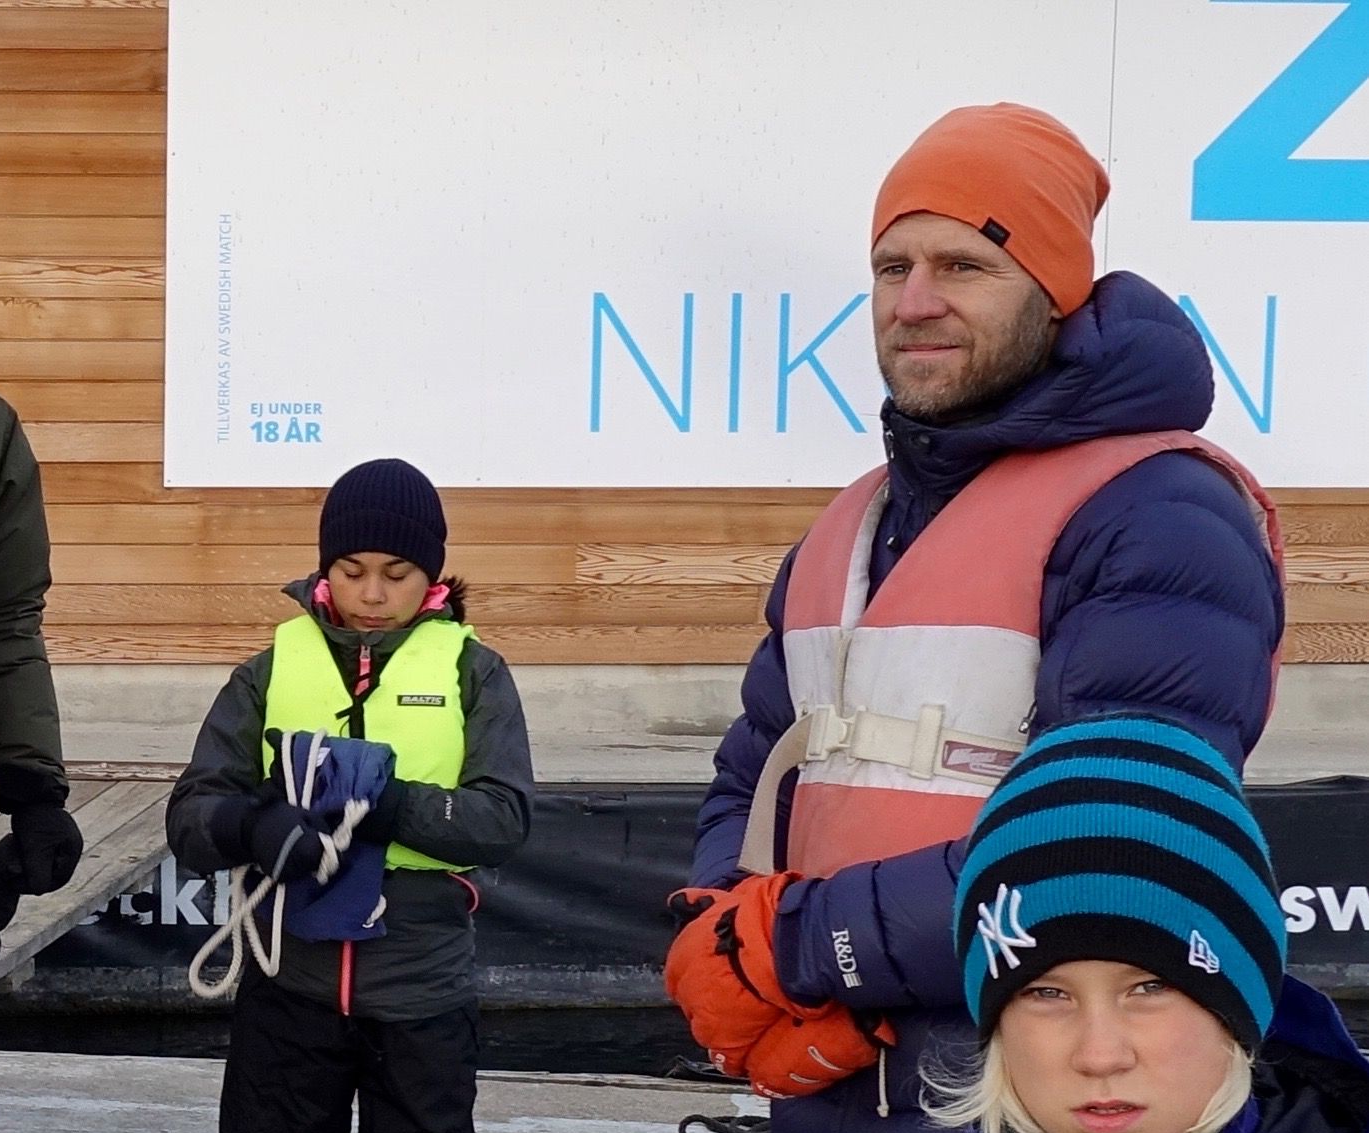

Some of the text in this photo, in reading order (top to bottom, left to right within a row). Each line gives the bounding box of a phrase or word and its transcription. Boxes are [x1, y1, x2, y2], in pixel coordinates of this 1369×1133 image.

[217, 214, 232, 444] TILLVERKAS AV SWEDISH MATCH
[250, 403, 323, 418] EJ UNDER
[250, 416, 323, 443] 18 ÅR
